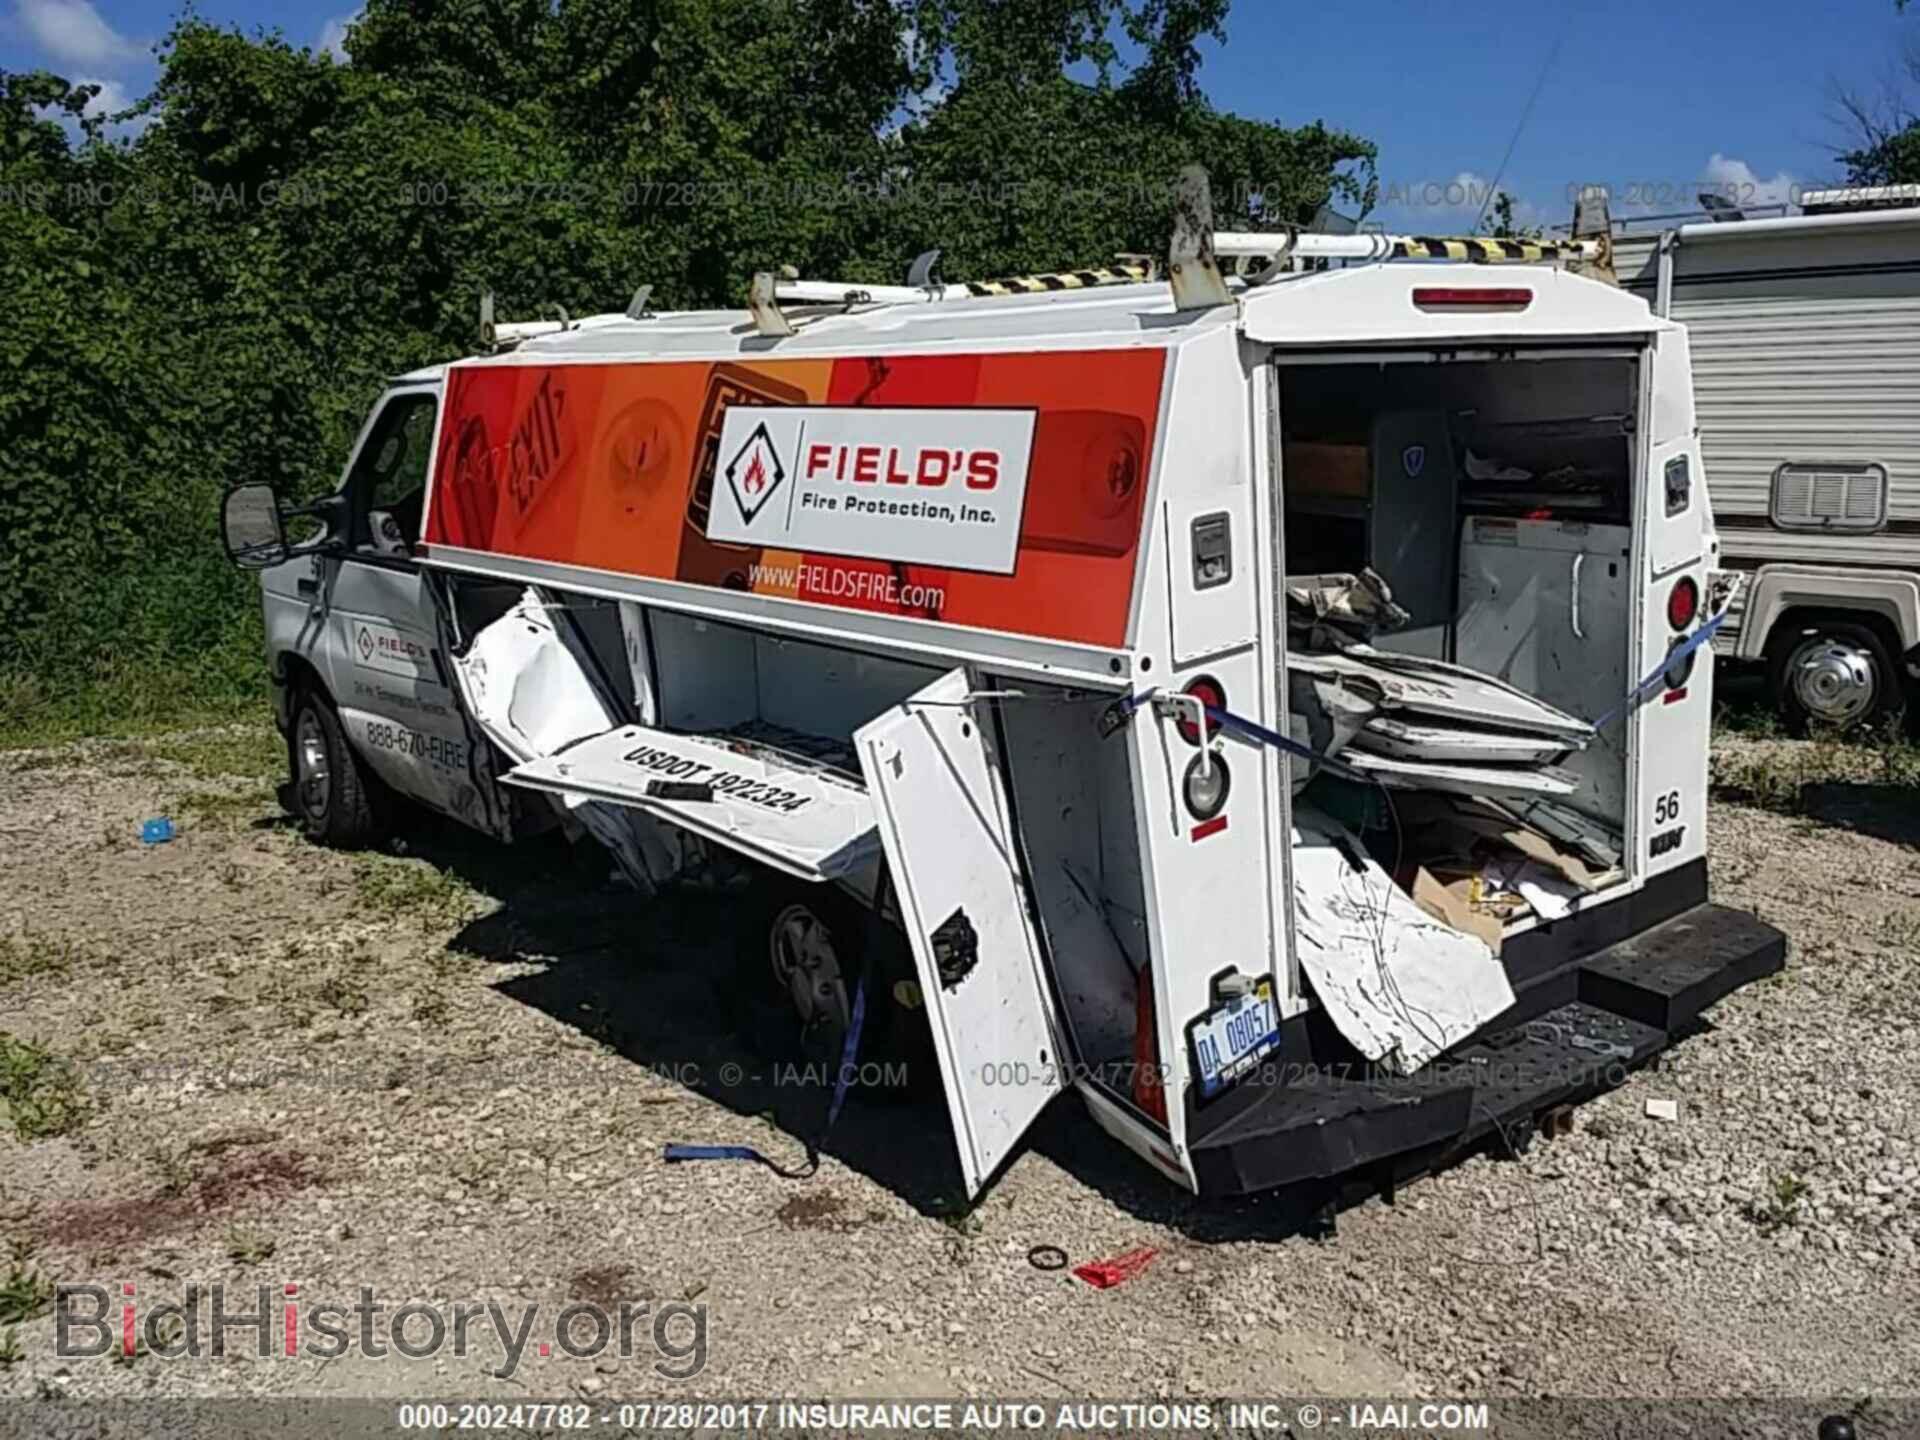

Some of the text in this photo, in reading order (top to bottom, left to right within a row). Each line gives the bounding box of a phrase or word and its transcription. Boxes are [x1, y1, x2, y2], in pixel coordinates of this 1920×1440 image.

[806, 445, 1000, 491] FIELD'S
[802, 492, 997, 524] Fire Protection, Inc.
[748, 563, 945, 609] www.FIELDSFIRE.com
[366, 721, 467, 770] 888-670-FIRE
[623, 746, 811, 812] USDOT 1922324
[1655, 790, 1679, 825] 56
[1198, 1033, 1224, 1076] DA
